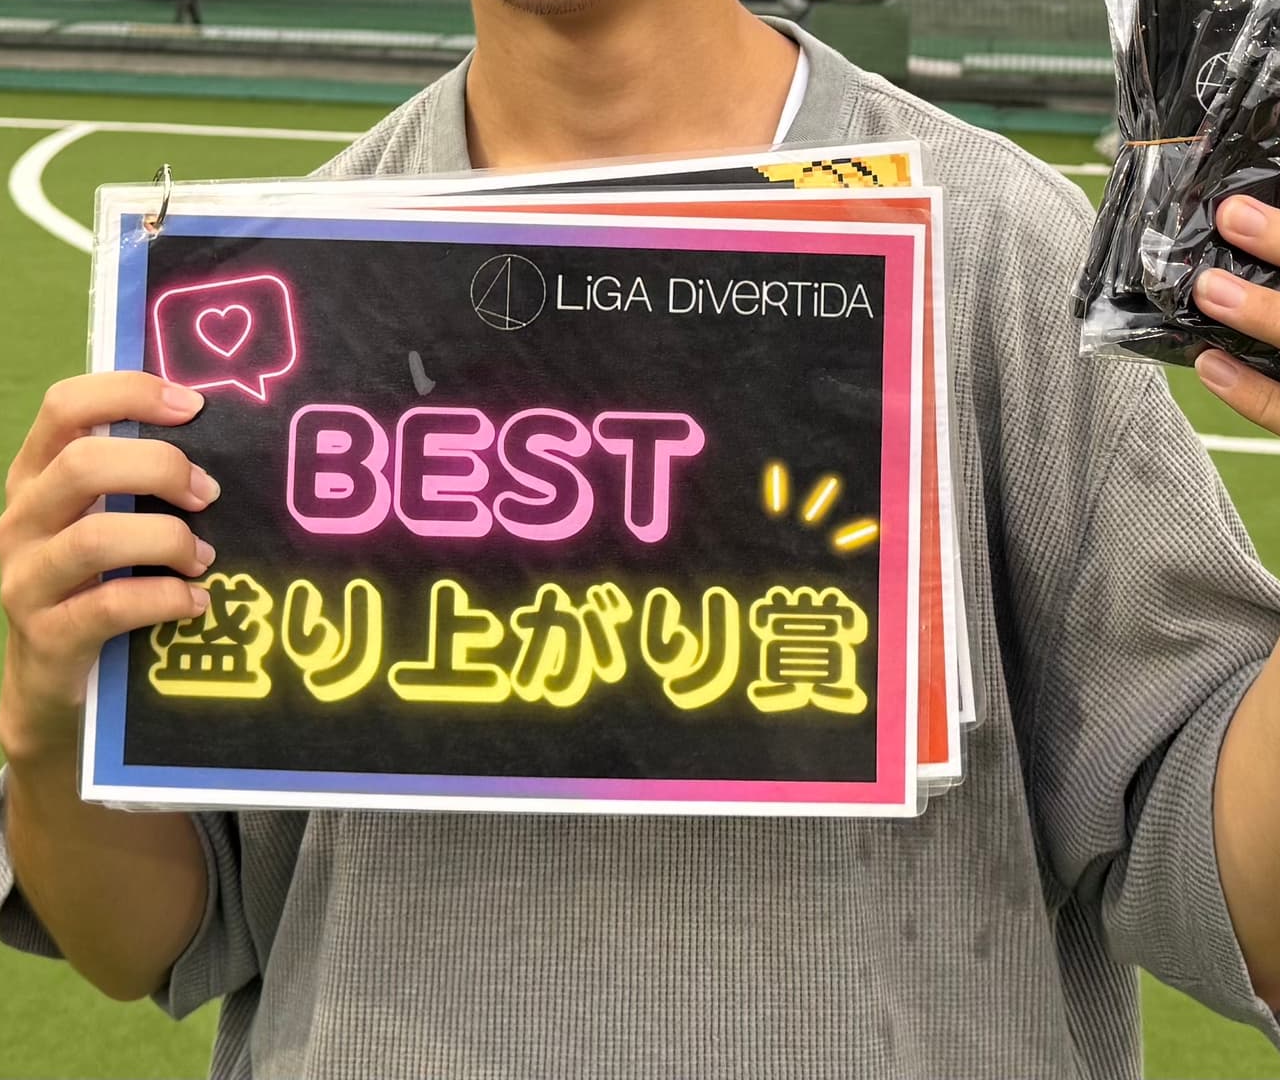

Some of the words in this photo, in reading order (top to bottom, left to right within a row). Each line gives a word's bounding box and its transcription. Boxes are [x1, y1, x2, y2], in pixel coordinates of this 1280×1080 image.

[286, 403, 705, 543] BEST
[149, 572, 868, 714] 盛り上がり賞
